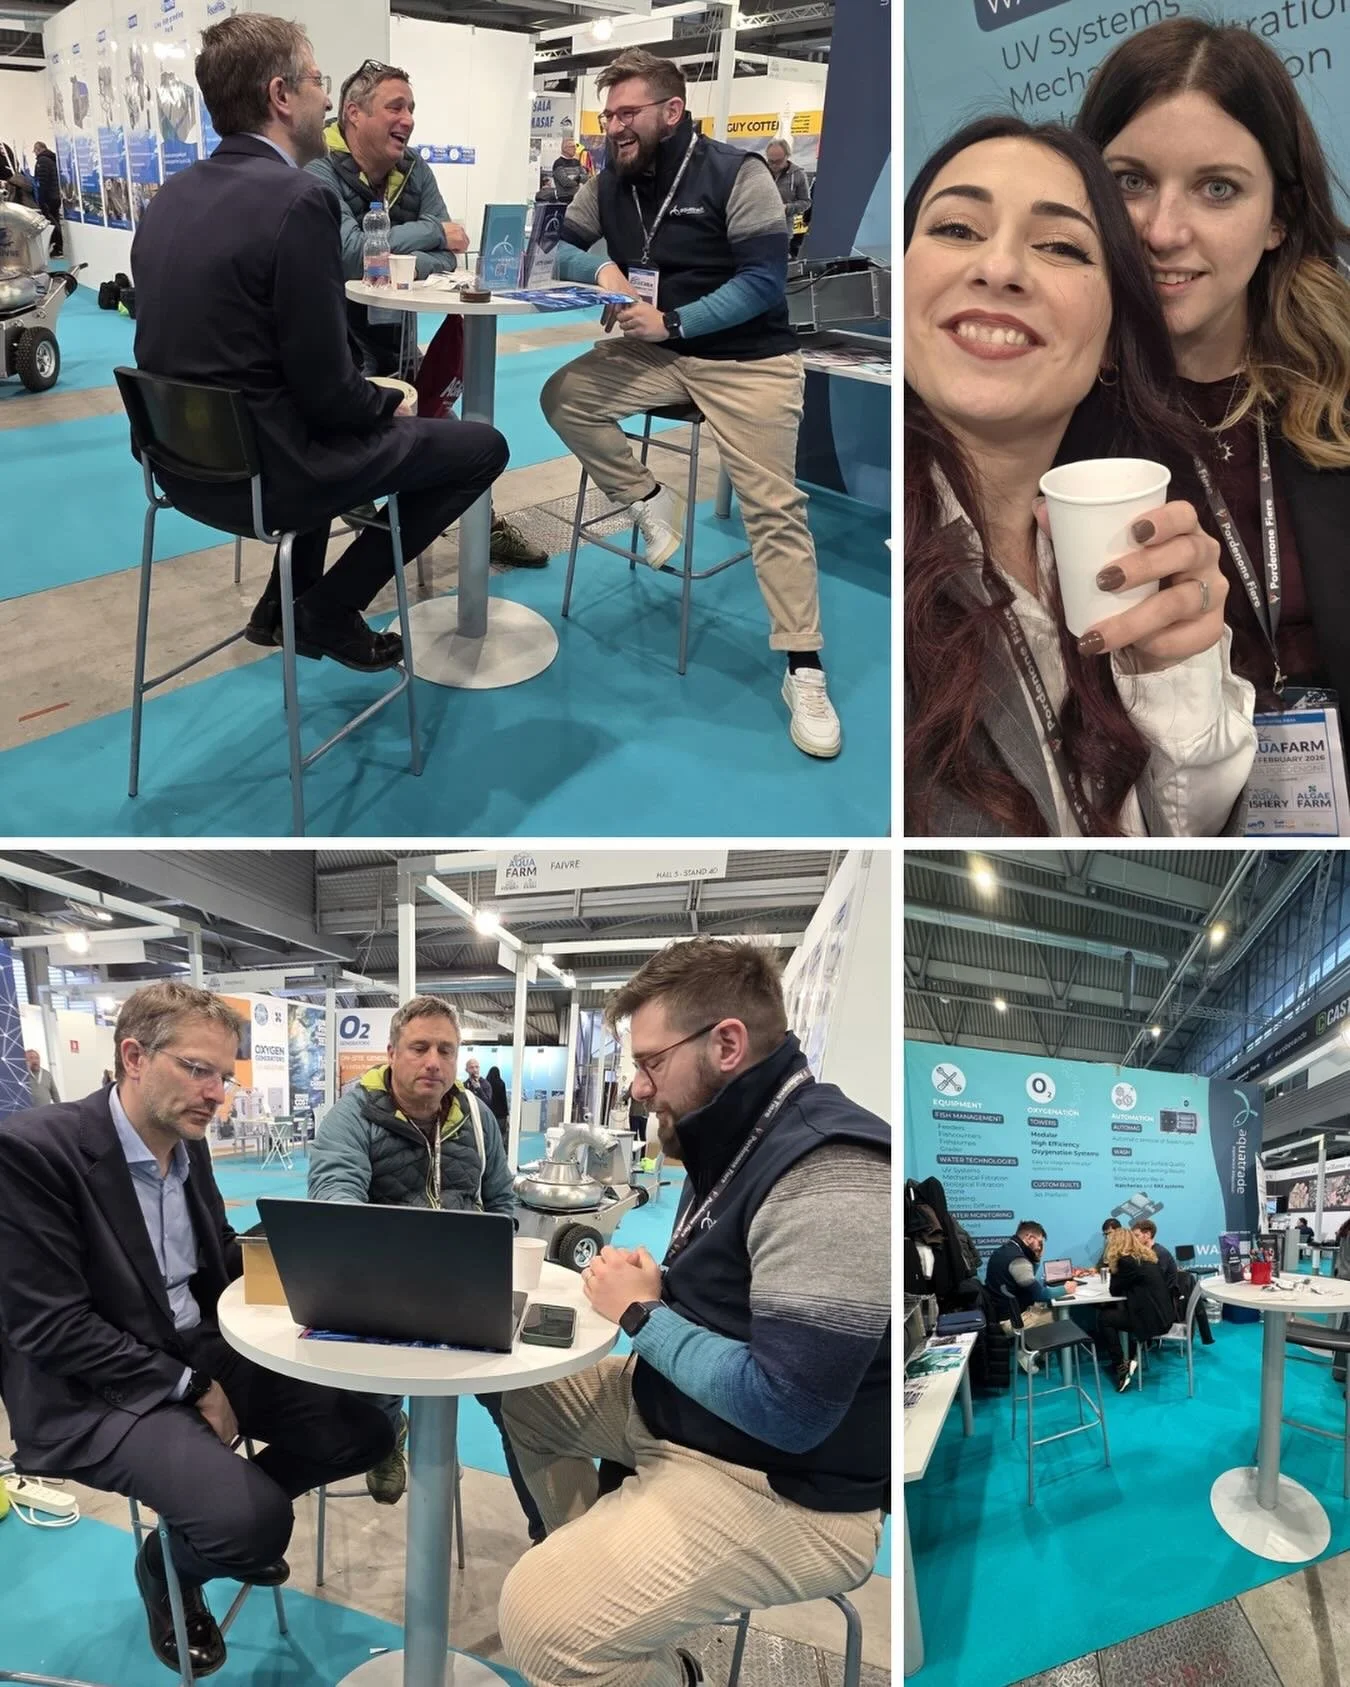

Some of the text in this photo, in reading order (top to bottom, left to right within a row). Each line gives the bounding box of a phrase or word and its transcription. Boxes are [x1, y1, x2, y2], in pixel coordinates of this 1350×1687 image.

[1001, 0, 1180, 71] UV Systems
[1284, 47, 1332, 79] on
[1009, 63, 1100, 110] Mecha
[727, 122, 746, 133] GUY
[1264, 498, 1279, 590] Pordenone Fiere
[1221, 522, 1261, 609] Pordenone Fiere
[1019, 645, 1056, 732] Pordenone
[1305, 754, 1325, 762] 2026
[1297, 791, 1331, 799] ALGAE
[1249, 800, 1289, 809] ISHERY
[1297, 799, 1332, 808] FARM
[508, 858, 536, 868] AQUA
[550, 859, 581, 871] FAIVRE
[505, 867, 538, 878] FARM
[656, 871, 672, 879] HALL
[339, 1015, 371, 1039] O2
[255, 1044, 286, 1055] OXYGEN
[932, 1098, 983, 1110] EQUIPMENT
[935, 1111, 1002, 1122] FISH MANAGEMENT
[1026, 1106, 1080, 1117] OXYGENATION
[1030, 1118, 1057, 1126] TOWERS
[1111, 1113, 1154, 1122] AUTOMATION
[1030, 1131, 1058, 1139] Modular
[1030, 1140, 1080, 1149] High Efficiency
[731, 1135, 758, 1169] Pordenone
[1031, 1148, 1073, 1157] Oxygenation
[939, 1155, 1017, 1166] WATER TECHNOLOGIES
[1236, 1128, 1248, 1194] aquatrade
[969, 1211, 1013, 1219] MONITORING
[1196, 1243, 1221, 1256] WA
